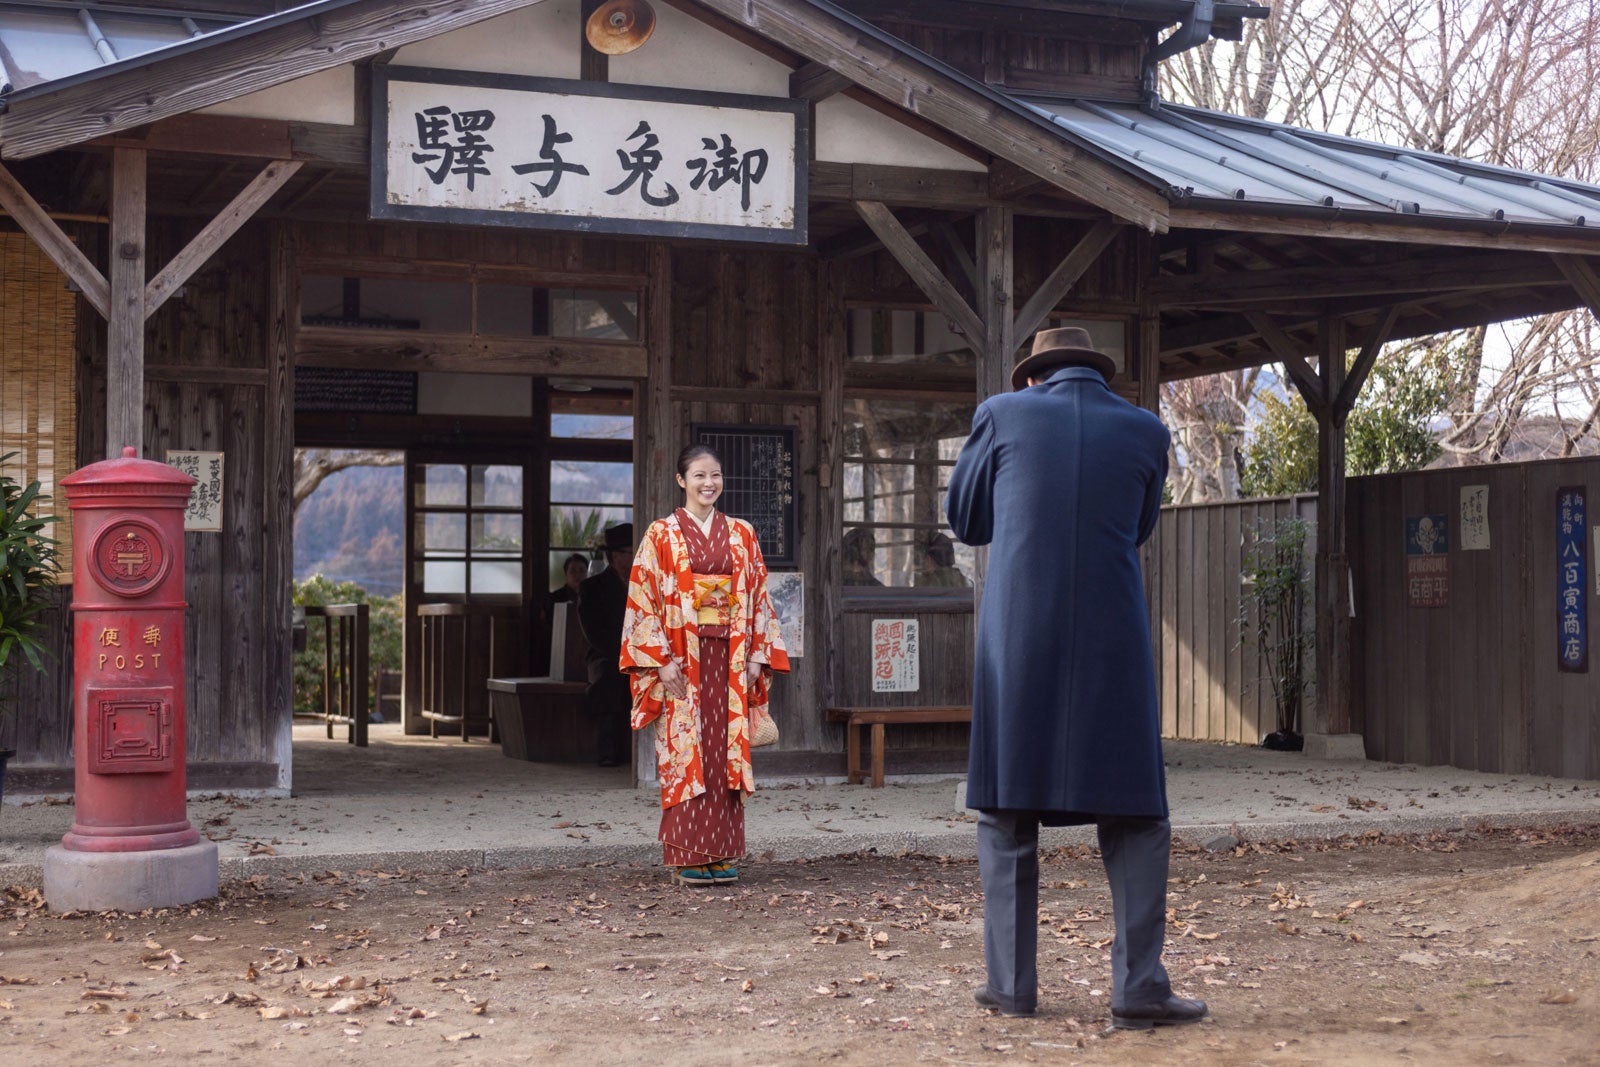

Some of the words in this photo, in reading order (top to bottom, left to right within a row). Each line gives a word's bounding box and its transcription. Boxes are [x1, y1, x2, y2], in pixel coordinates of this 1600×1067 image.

[783, 451, 793, 505] お忘れ物
[1563, 540, 1580, 660] 八百寅商店
[98, 653, 162, 670] POST
